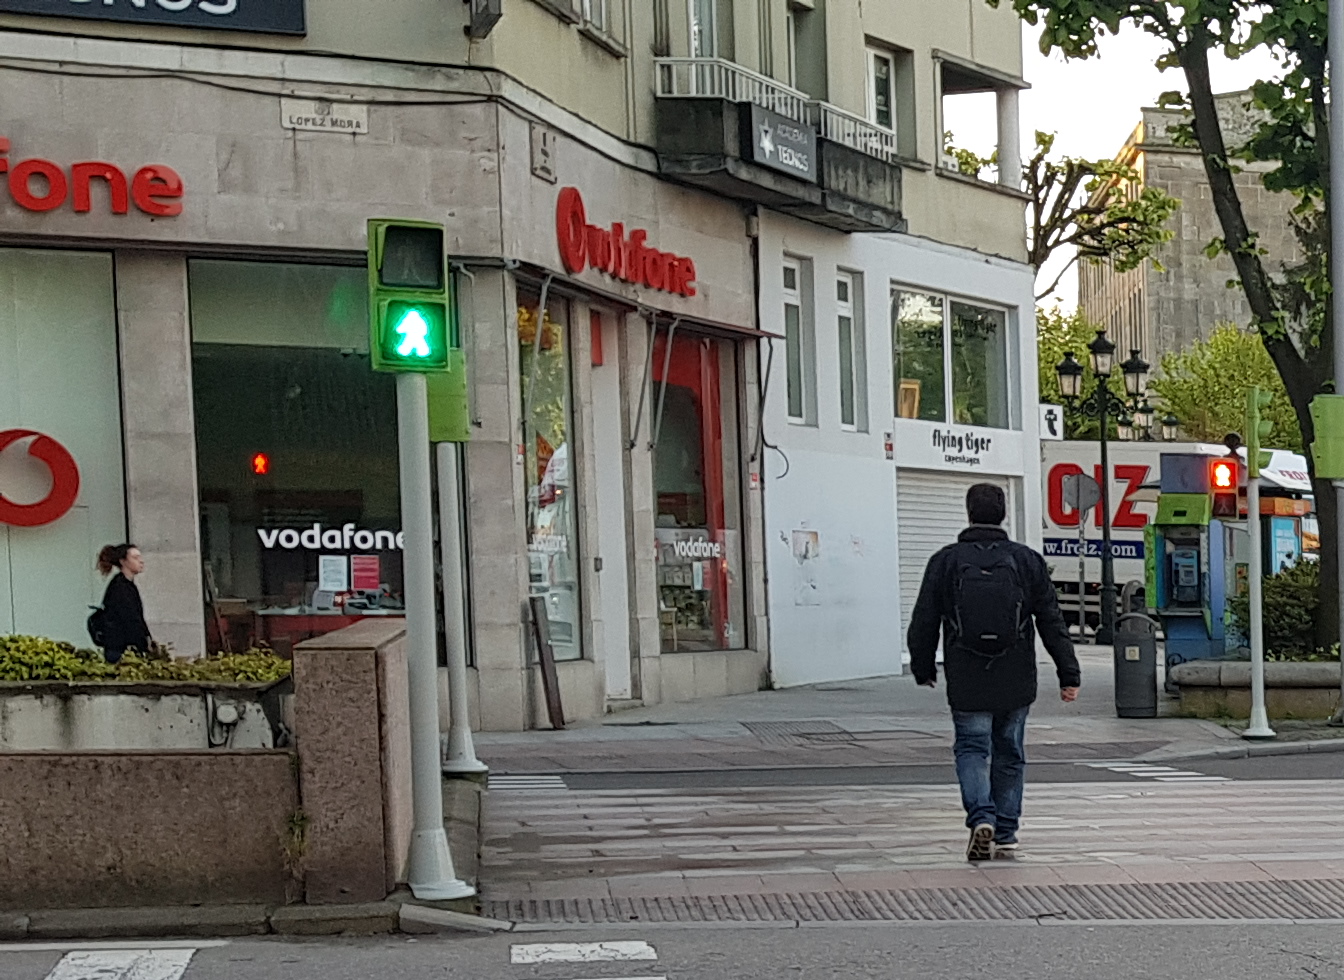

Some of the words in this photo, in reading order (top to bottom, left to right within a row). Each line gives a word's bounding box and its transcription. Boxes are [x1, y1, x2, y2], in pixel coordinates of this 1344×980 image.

[289, 115, 326, 127] LOPEZ
[330, 118, 361, 128] MORA
[932, 429, 963, 453] flying
[965, 432, 991, 454] tiger
[673, 536, 721, 558] vodafone
